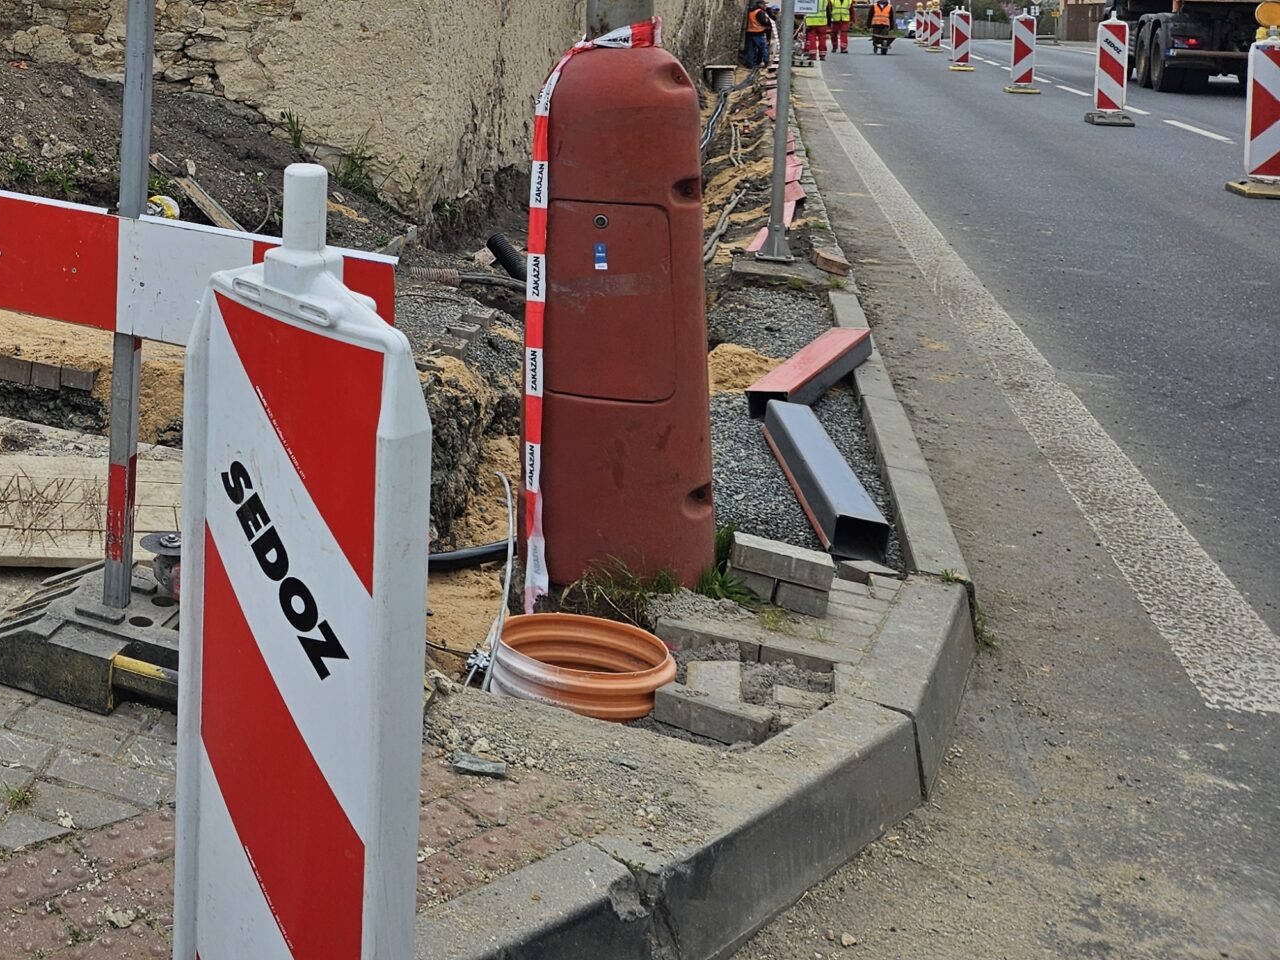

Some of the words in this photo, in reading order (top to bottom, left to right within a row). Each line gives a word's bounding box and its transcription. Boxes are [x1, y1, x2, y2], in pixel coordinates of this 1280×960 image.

[1103, 38, 1122, 54] SEDOZ
[532, 256, 540, 296] ZAKÁZÁN
[221, 460, 350, 681] SEDOZ
